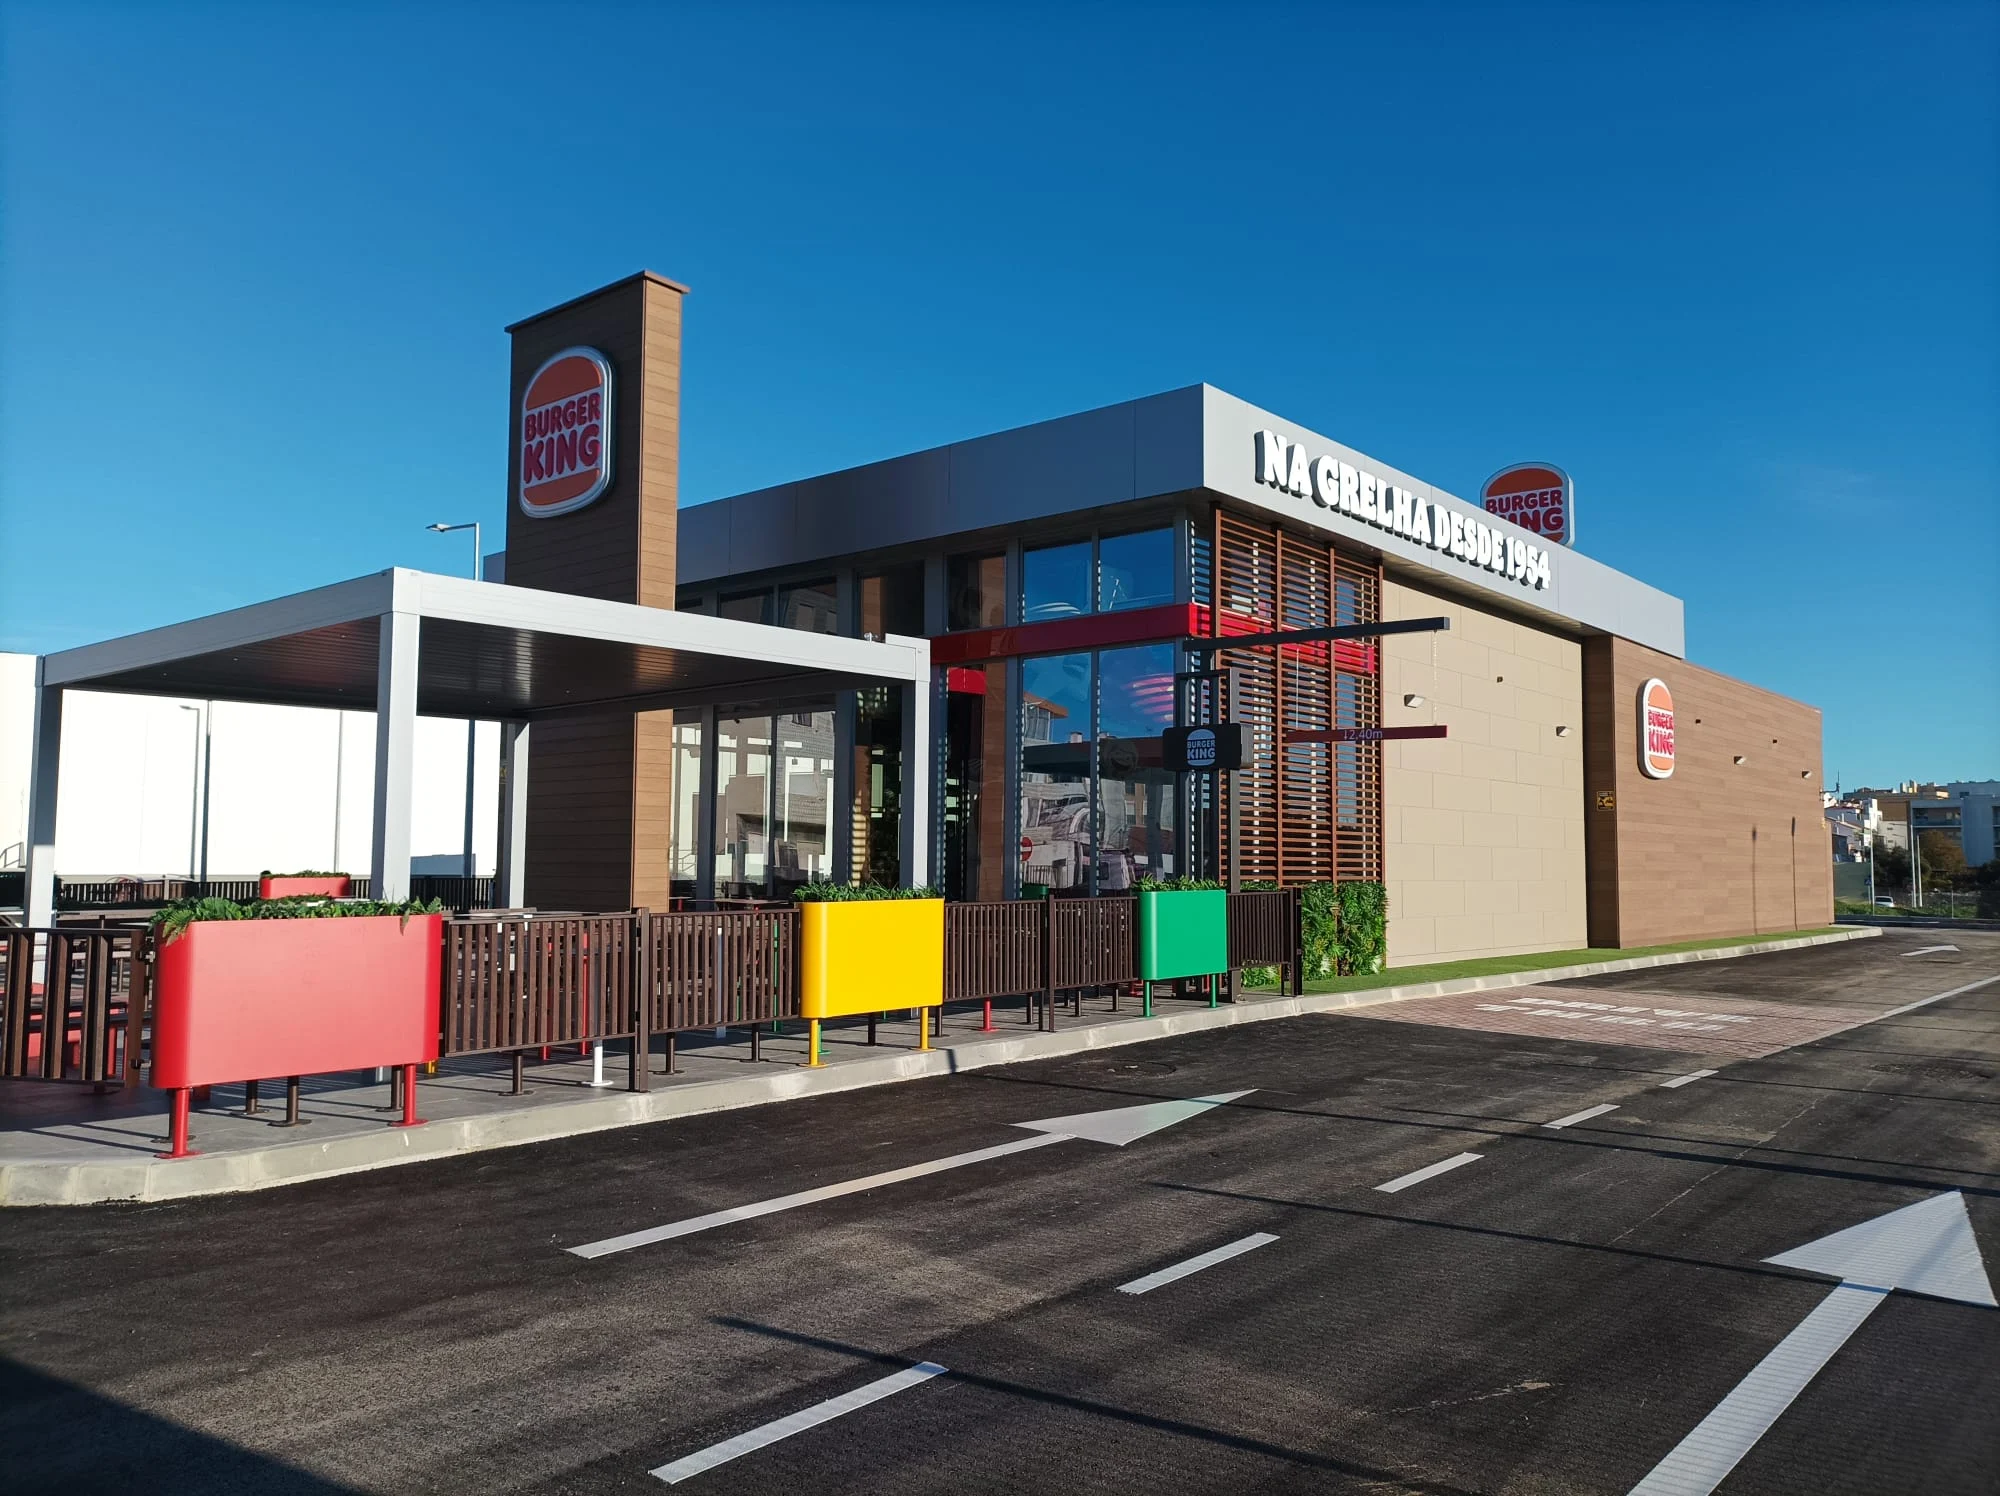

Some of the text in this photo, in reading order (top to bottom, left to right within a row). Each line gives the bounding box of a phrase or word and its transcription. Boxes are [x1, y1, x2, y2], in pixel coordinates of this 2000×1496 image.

[524, 392, 601, 442] BURGER
[523, 423, 600, 484] KING
[1254, 429, 1551, 591] NA GRELHA DESDE 1954
[1485, 489, 1563, 514] BURGER
[1647, 710, 1674, 730] BURGER
[1187, 740, 1216, 749] BURGER
[1187, 747, 1216, 760] KING
[1648, 728, 1674, 756] KING
